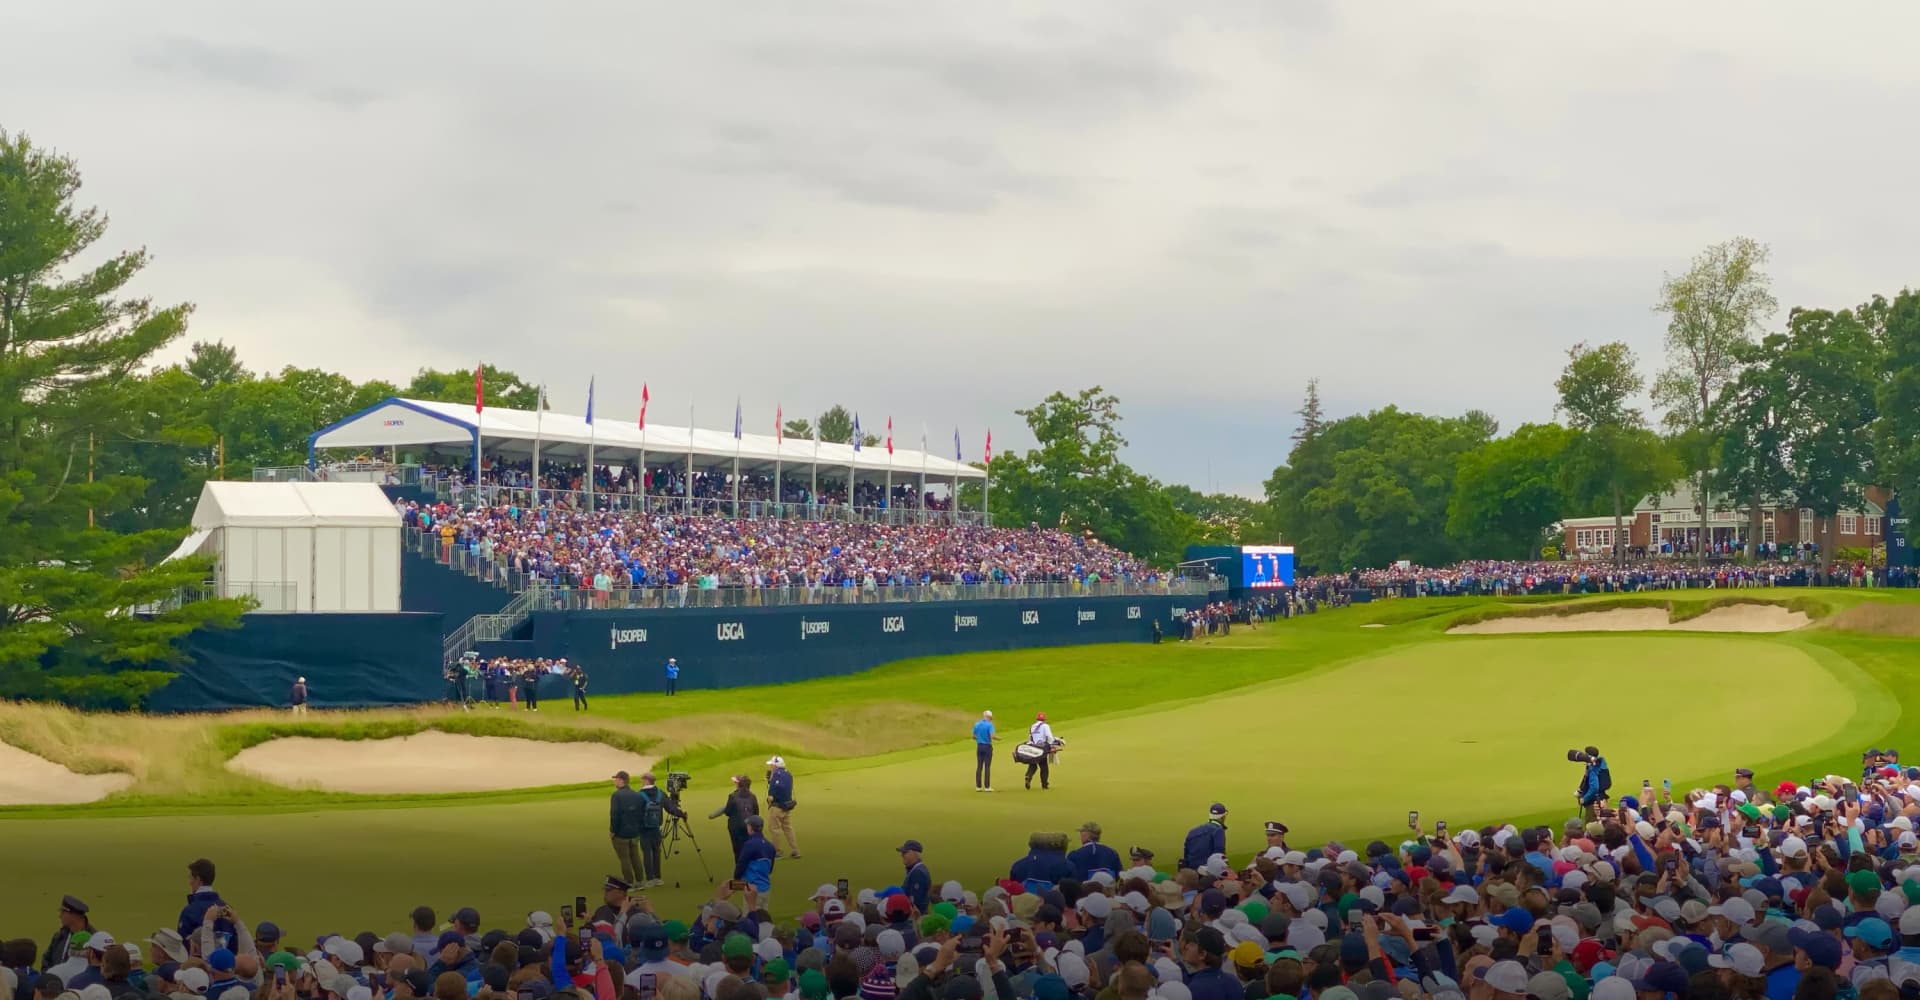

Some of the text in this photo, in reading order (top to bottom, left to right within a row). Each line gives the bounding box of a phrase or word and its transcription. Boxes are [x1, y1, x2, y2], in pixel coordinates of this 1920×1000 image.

[1896, 538, 1905, 547] 18
[1022, 610, 1039, 624] USGA
[1127, 606, 1141, 619] USGA
[717, 622, 744, 640] USGA
[883, 616, 904, 632] USGA
